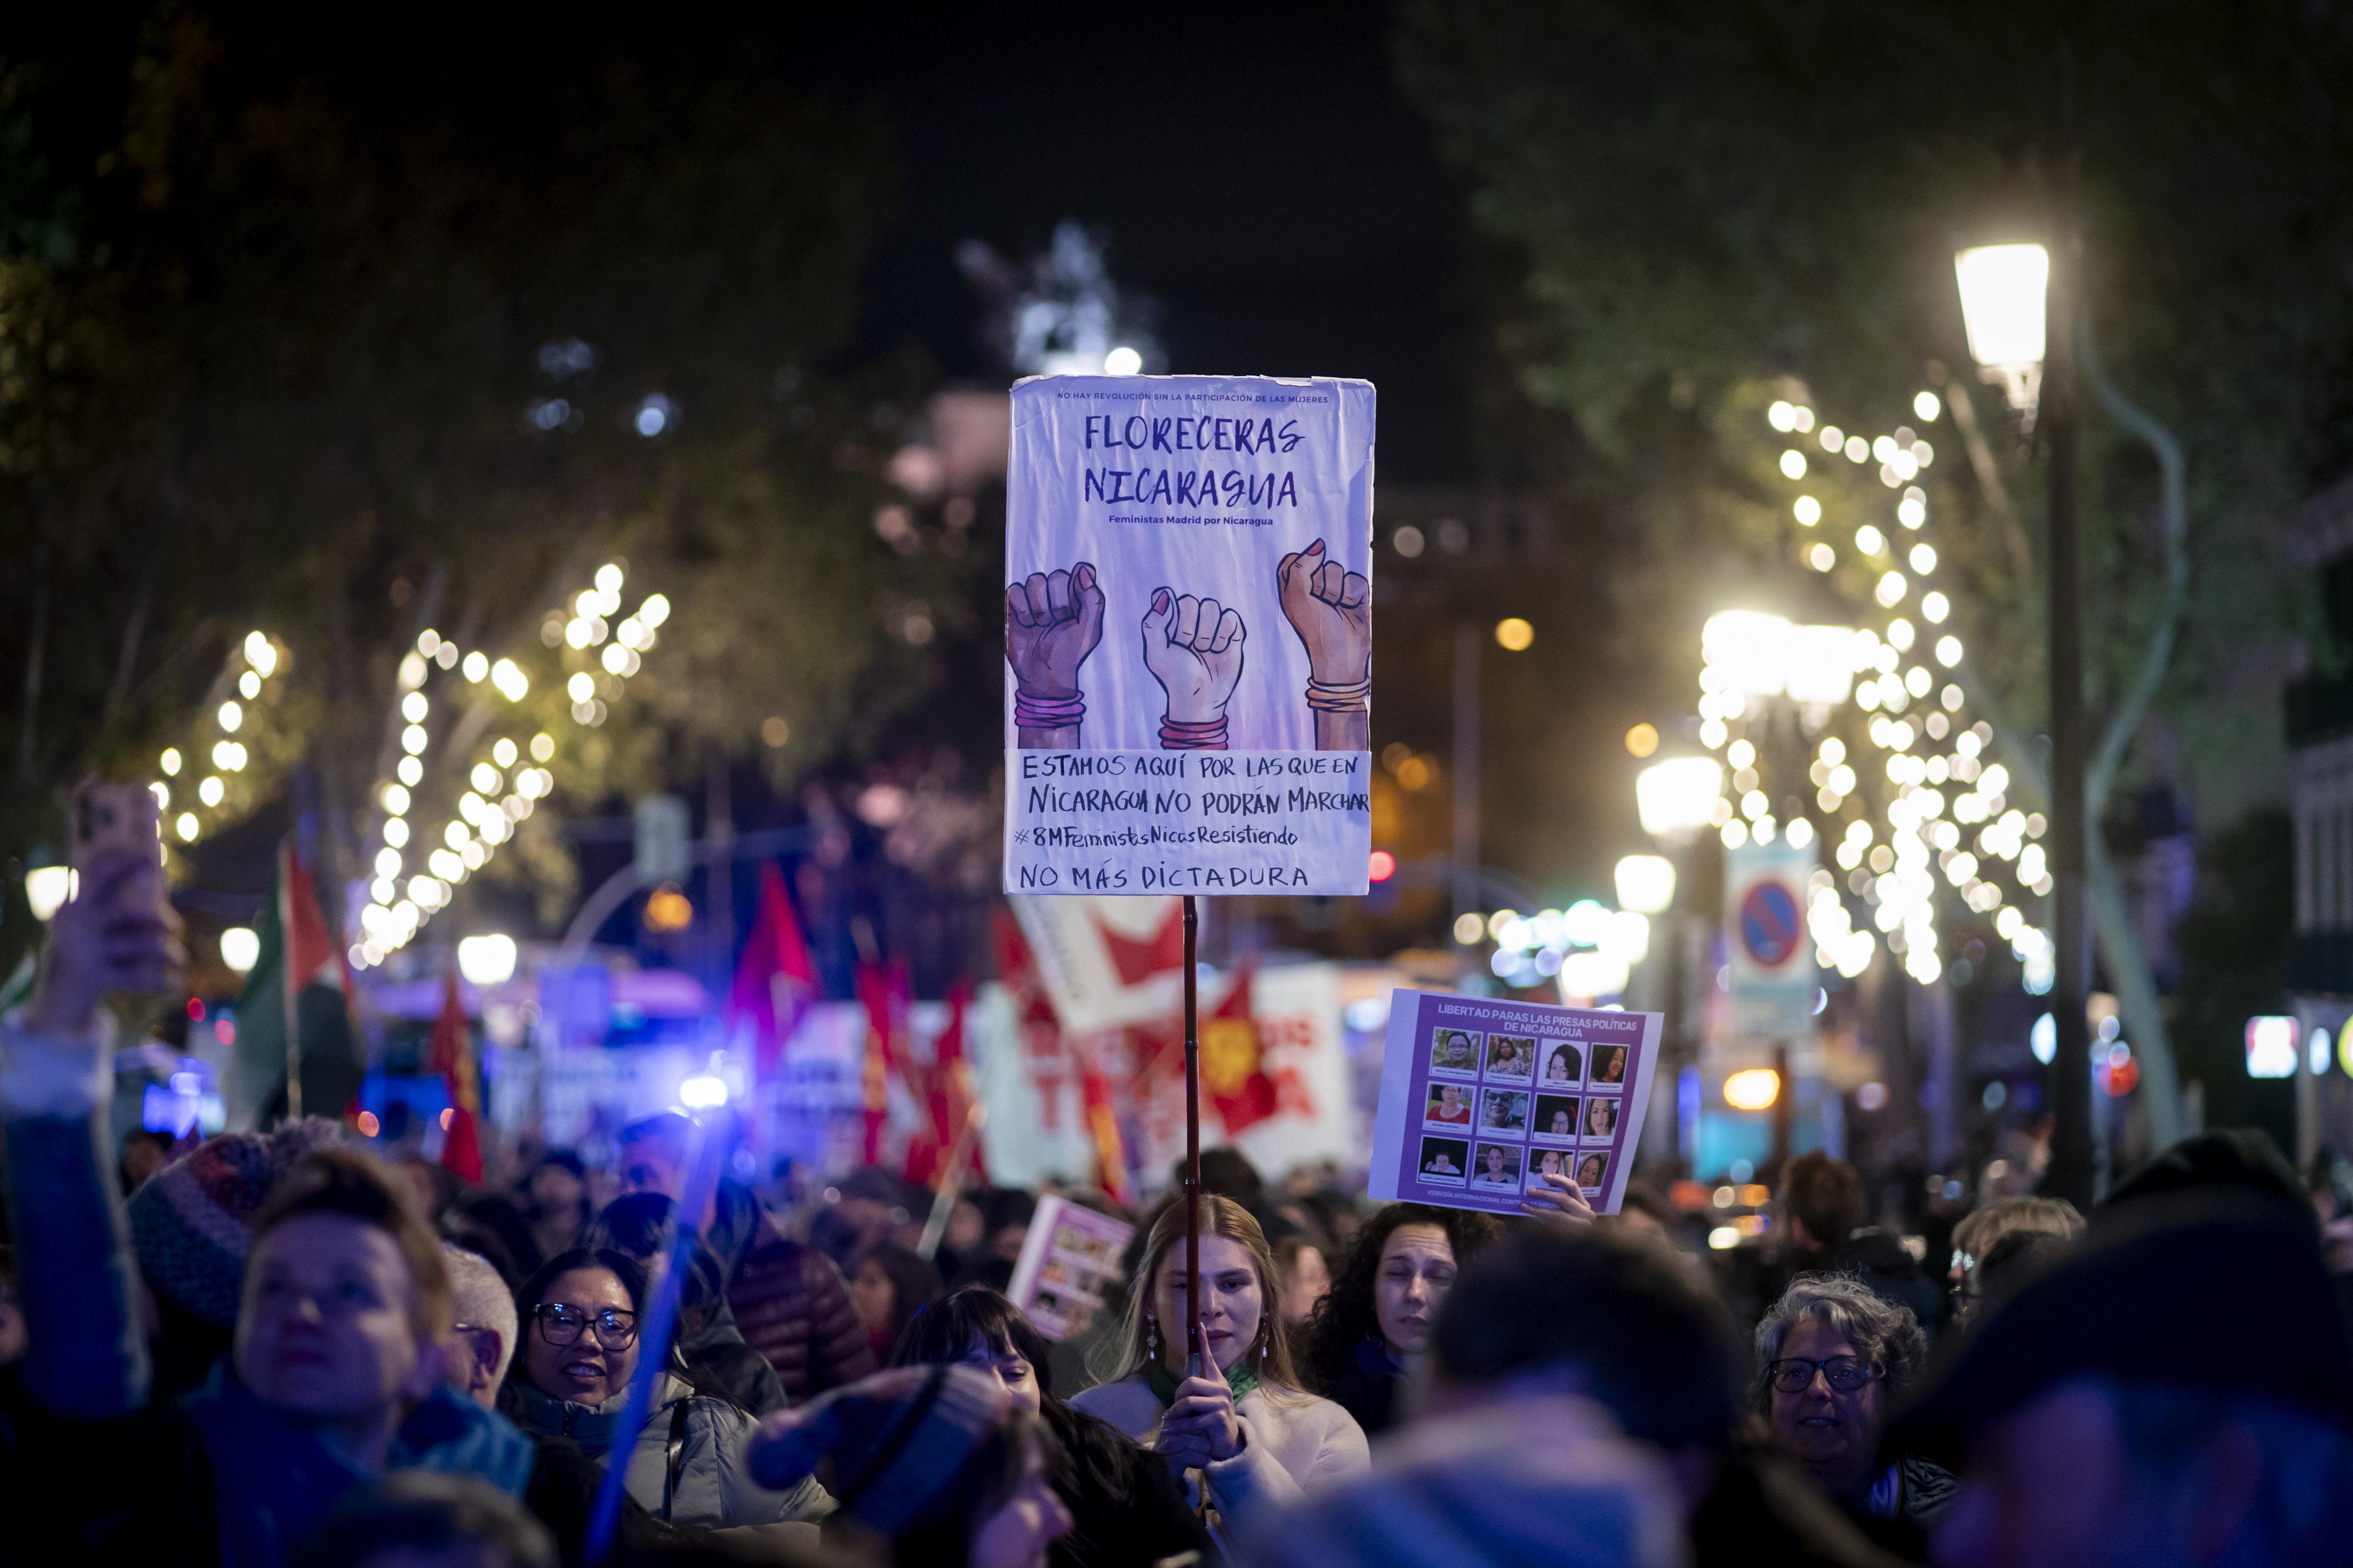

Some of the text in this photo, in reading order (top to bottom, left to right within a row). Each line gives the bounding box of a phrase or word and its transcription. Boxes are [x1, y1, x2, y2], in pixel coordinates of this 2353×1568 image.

[1095, 392, 1151, 400] REVOLUCIÓN
[1185, 393, 1252, 402] PARTICIPACIÓN
[1086, 415, 1305, 456] FLORECERAS
[1085, 468, 1298, 509] NICARAGUA
[1109, 515, 1164, 524] Feministas
[1166, 515, 1201, 525] Madrid
[1223, 516, 1274, 526] Nicaragua
[1024, 753, 1358, 779] ESTAMOS AQUÍ POR LAS QUE EN
[1155, 789, 1191, 815] NO
[1201, 785, 1280, 816] PODRÁN
[1288, 786, 1370, 812] MARCHAR
[1021, 863, 1058, 888] NO
[1072, 858, 1128, 889] MÁS
[1438, 1003, 1637, 1031] LIBERTAD PARAS LAS PRESAS POLÍTICAS
[1504, 1021, 1583, 1038] DE NICARAGUA
